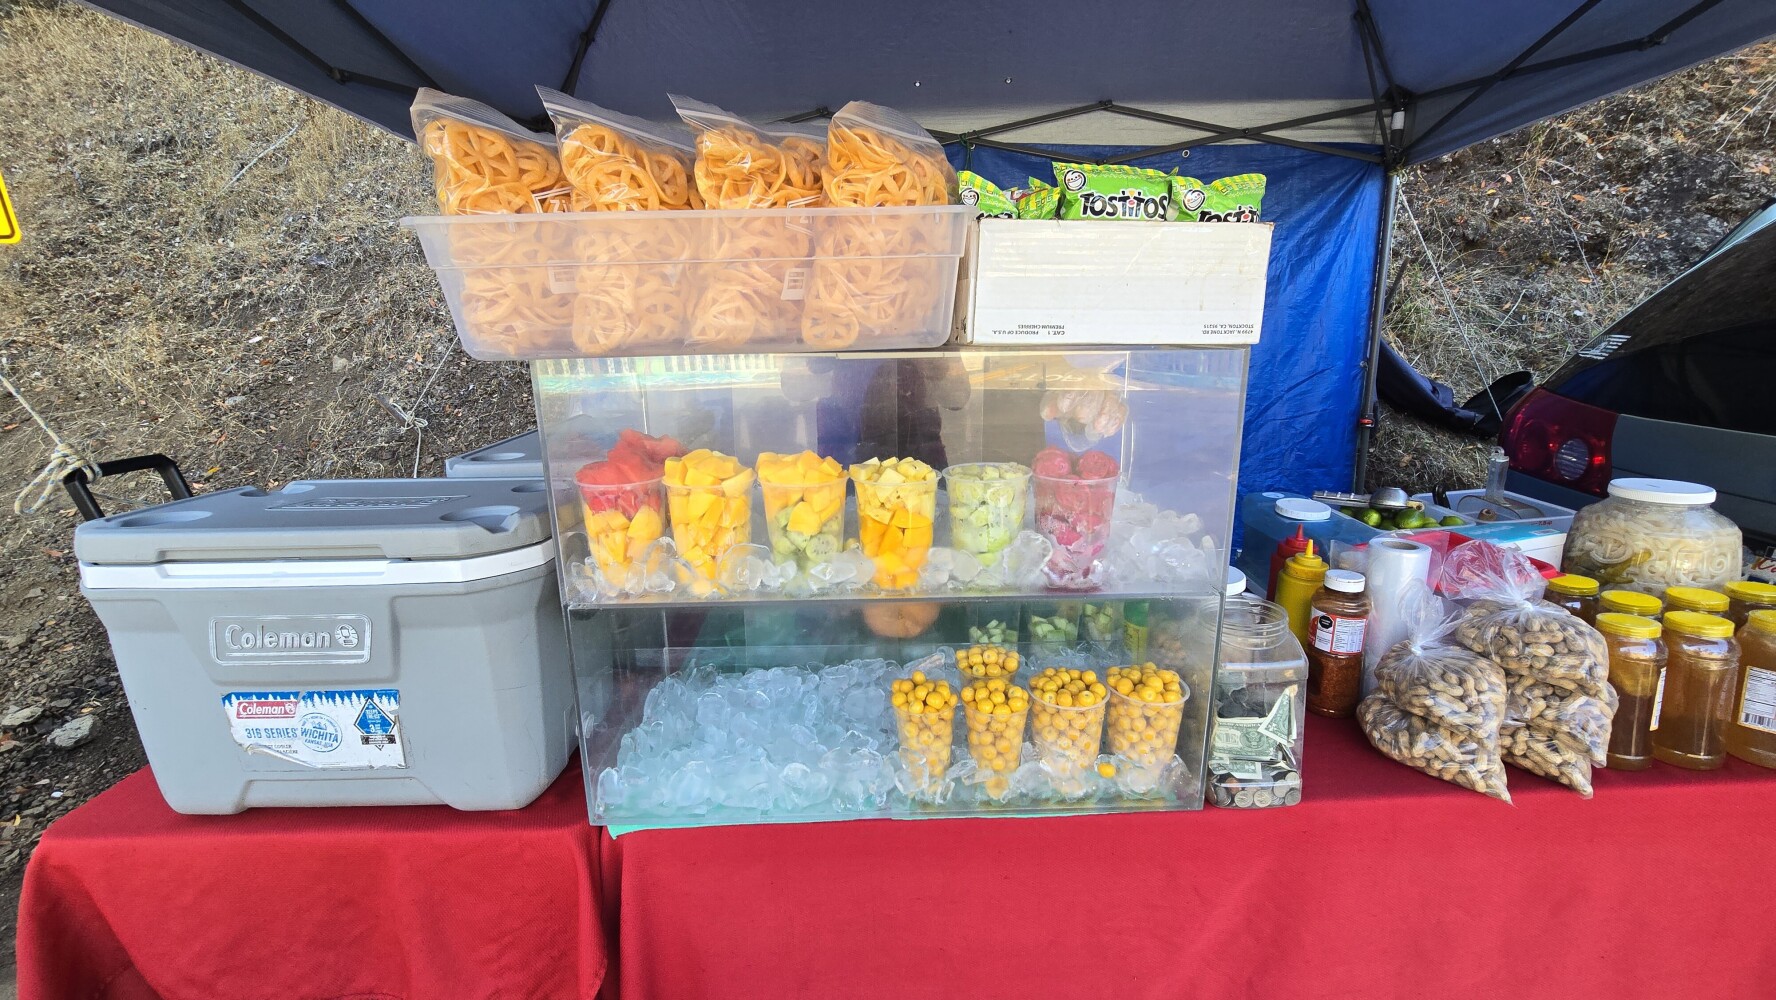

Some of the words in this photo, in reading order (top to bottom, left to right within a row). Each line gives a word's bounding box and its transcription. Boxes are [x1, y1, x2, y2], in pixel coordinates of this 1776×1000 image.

[225, 624, 331, 650] Coleman
[239, 702, 285, 715] Coleman
[245, 727, 262, 739] 316
[264, 727, 298, 739] SERIES
[300, 727, 339, 743] WICHITA
